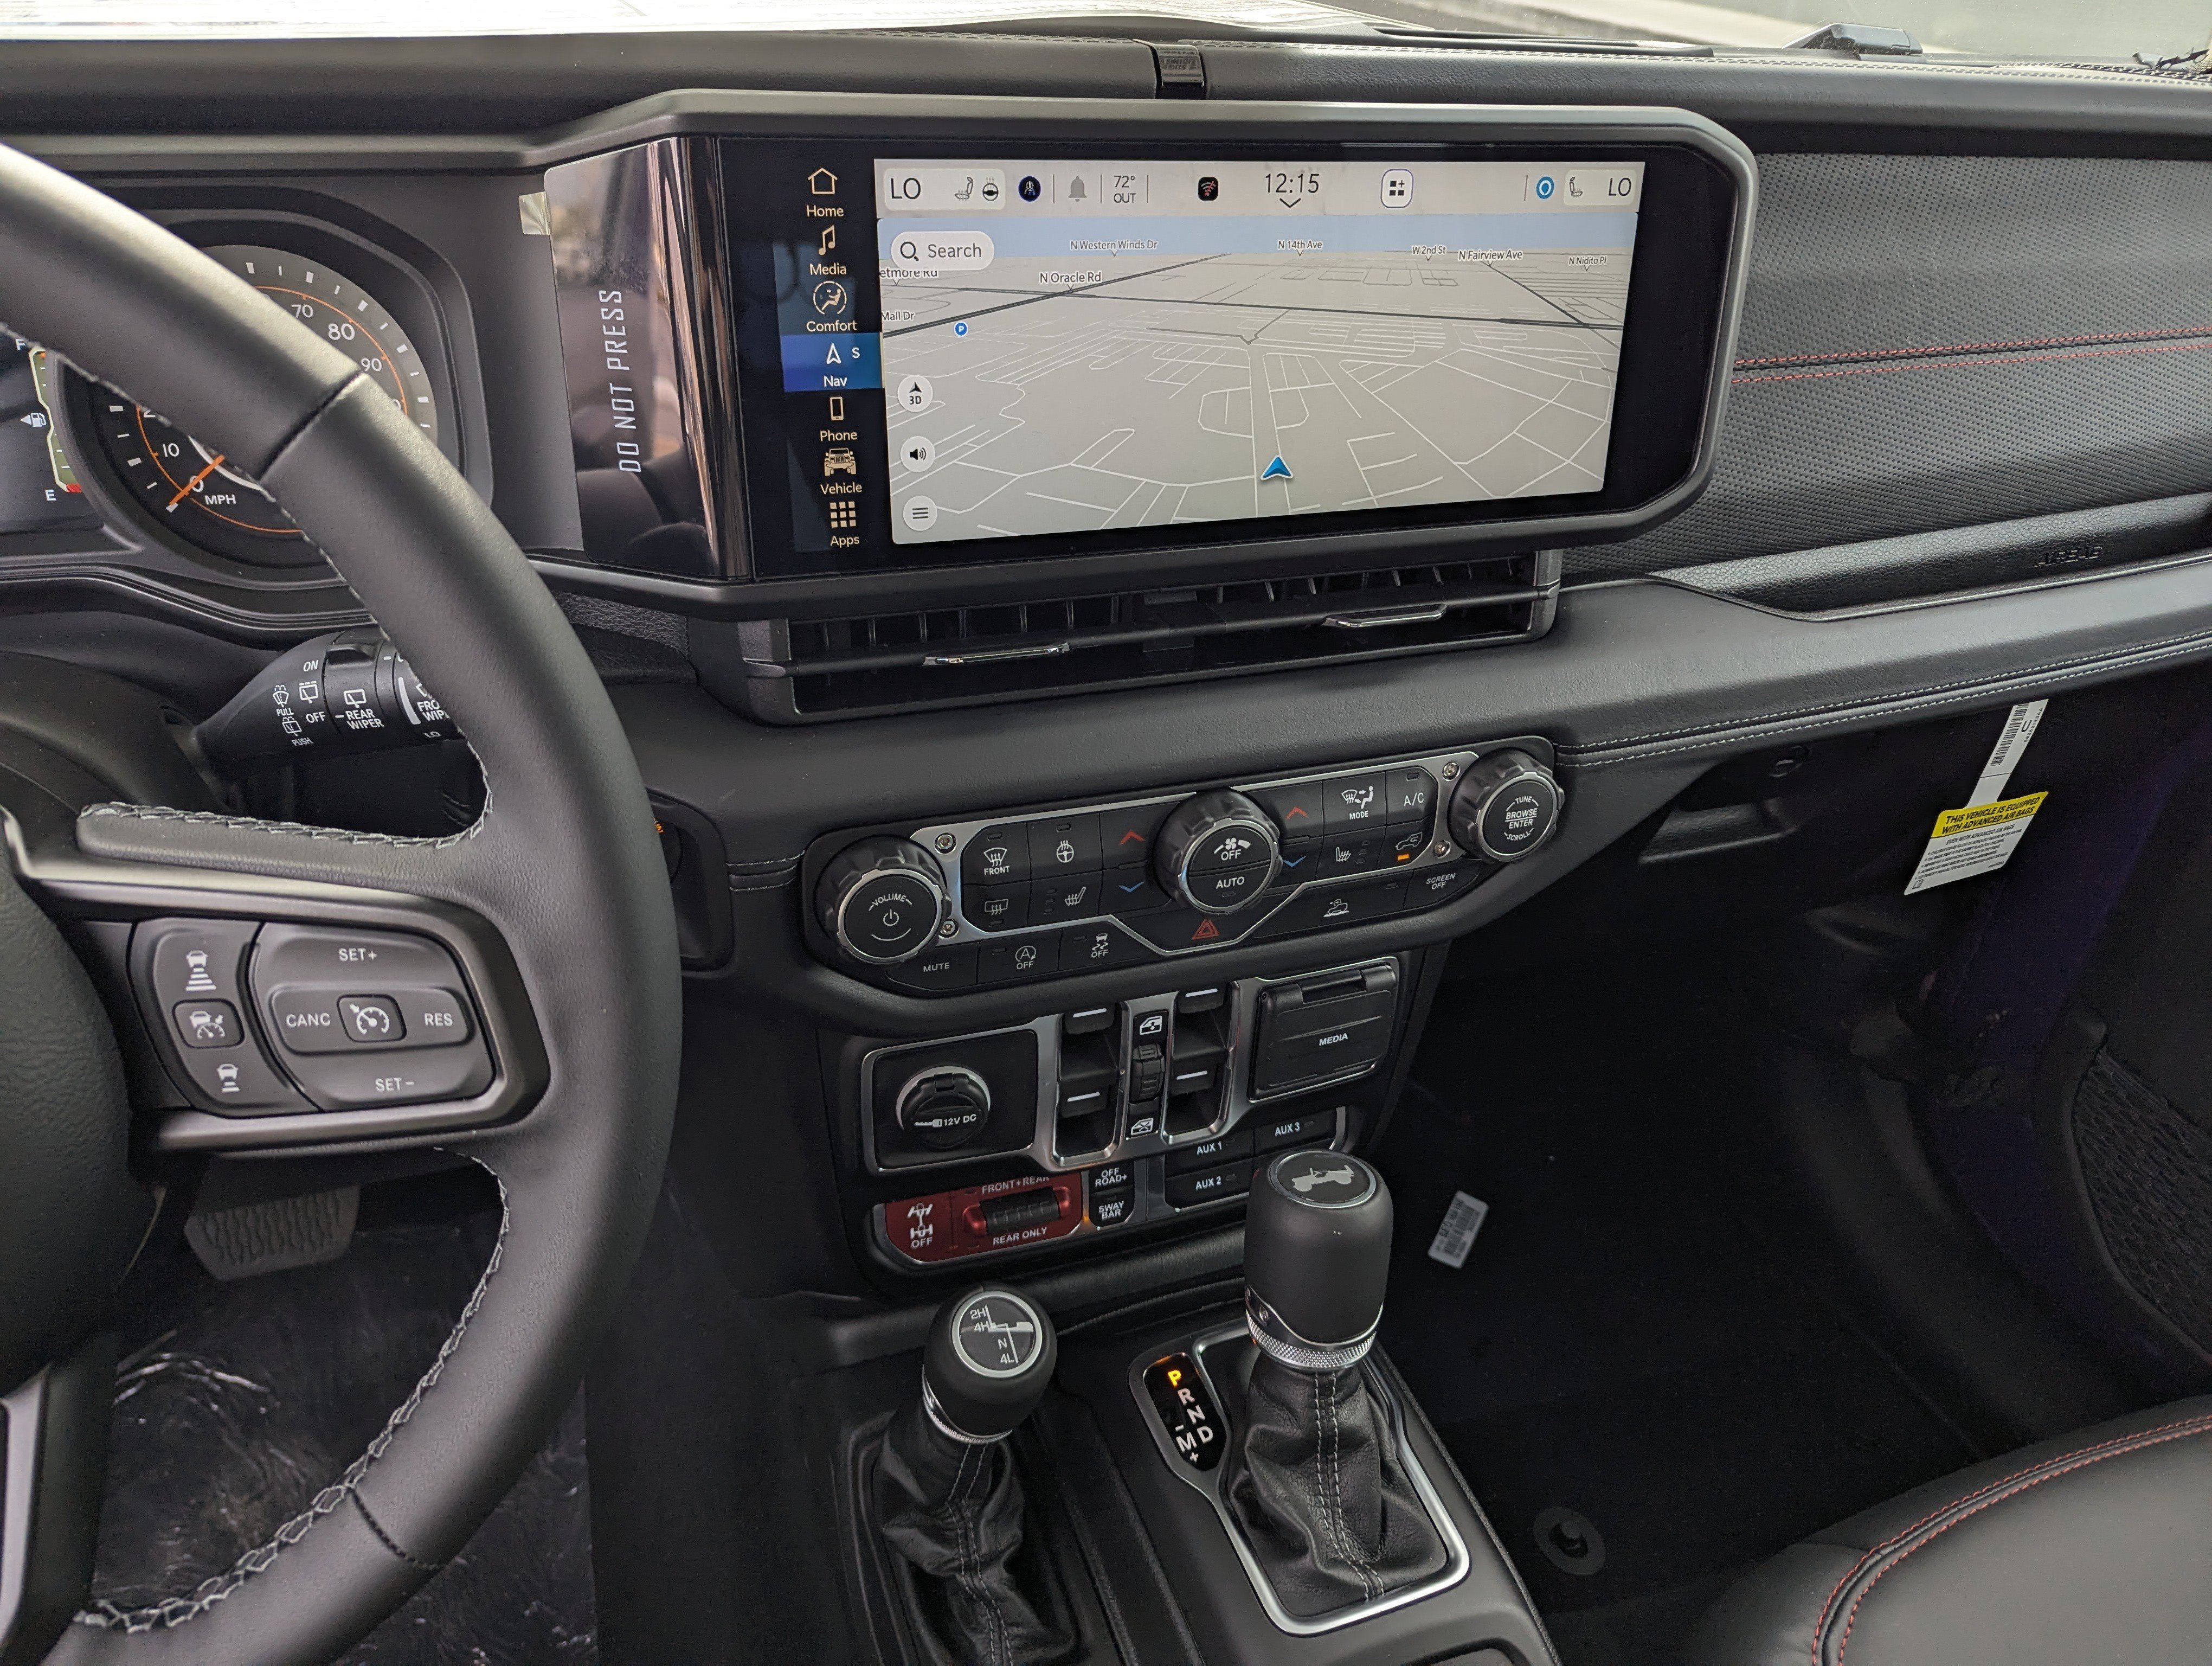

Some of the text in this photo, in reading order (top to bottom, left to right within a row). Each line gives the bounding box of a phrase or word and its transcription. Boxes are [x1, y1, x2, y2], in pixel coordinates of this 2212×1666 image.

[890, 177, 922, 200] LO
[1265, 173, 1320, 194] 12:15
[1608, 177, 1632, 197] LO
[1113, 193, 1136, 204] OUT
[806, 205, 844, 217] Home
[1070, 240, 1158, 249] N Western Winds Dr
[1278, 240, 1323, 249] N 14th Ave
[1412, 246, 1446, 254] W 2nd St
[927, 244, 982, 259] Search
[1459, 250, 1522, 260] N Fairview Ave
[1576, 257, 1598, 265] Nidito
[809, 263, 847, 275] Media
[1039, 271, 1102, 283] N Oracle Rd
[291, 304, 313, 318] 70
[881, 311, 915, 321] Mall Dr
[328, 323, 355, 340] 80
[806, 319, 857, 332] Comfort
[15, 338, 25, 350] F
[852, 347, 860, 358] S
[361, 358, 382, 371] 90
[598, 290, 641, 473] DO NOT PRESS
[823, 375, 847, 387] Nav
[909, 395, 922, 405] 3D
[820, 430, 858, 441] Phone
[163, 443, 180, 458] 10
[820, 482, 863, 495] Vehicle
[45, 489, 56, 501] E
[204, 494, 237, 505] MPH
[830, 535, 860, 548] Apps
[303, 660, 319, 672] ON
[416, 700, 440, 712] FRO
[276, 708, 295, 717] PULL
[305, 712, 326, 724] OFF
[345, 708, 376, 721] REAR
[422, 709, 445, 721] WIP
[346, 719, 384, 731] WIPER
[291, 736, 313, 747] PUSH
[1404, 792, 1425, 807] A/C
[1515, 795, 1533, 805] TUNE
[1349, 810, 1369, 820] MODE
[1506, 807, 1538, 820] BROWSE
[1946, 796, 2041, 824] THIS VEHICLE IS EQUIPPED
[1508, 818, 1533, 829] ENTER
[1941, 806, 2035, 835] WITH ADVANCED AIR BAGS
[1506, 831, 1530, 841] SCROLL
[1220, 848, 1242, 861] OFF
[983, 866, 1010, 875] FRONT
[1215, 876, 1245, 889] AUTO
[1426, 873, 1456, 885] SCREEN
[1431, 881, 1447, 890] OFF
[872, 893, 907, 907] VOLUME
[1091, 948, 1109, 958] OFF
[923, 962, 950, 973] MUTE
[1016, 959, 1034, 970] OFF
[286, 1013, 331, 1028] CANC
[424, 1013, 453, 1027] RES
[1319, 1033, 1348, 1047] MEDIA
[943, 1113, 978, 1127] 12V DC
[1274, 1121, 1301, 1137] AUX 3
[1196, 1141, 1223, 1156] AUX 1
[1101, 1167, 1120, 1178] OFF
[1095, 1173, 1128, 1188] ROAD+
[1195, 1176, 1221, 1190] AUX 2
[1098, 1200, 1125, 1214] SWAY
[1101, 1208, 1121, 1221] BAR
[911, 1236, 933, 1249] OFF
[993, 1227, 1047, 1247] REAR ONLY
[970, 1308, 986, 1320] 2H
[974, 1320, 989, 1332] 4H
[997, 1337, 1008, 1349] N
[1000, 1353, 1015, 1364] 4L
[1167, 1369, 1181, 1388] P
[1177, 1388, 1195, 1406] R
[1187, 1405, 1206, 1425] N
[1197, 1426, 1214, 1444] D
[1175, 1432, 1198, 1453] M
